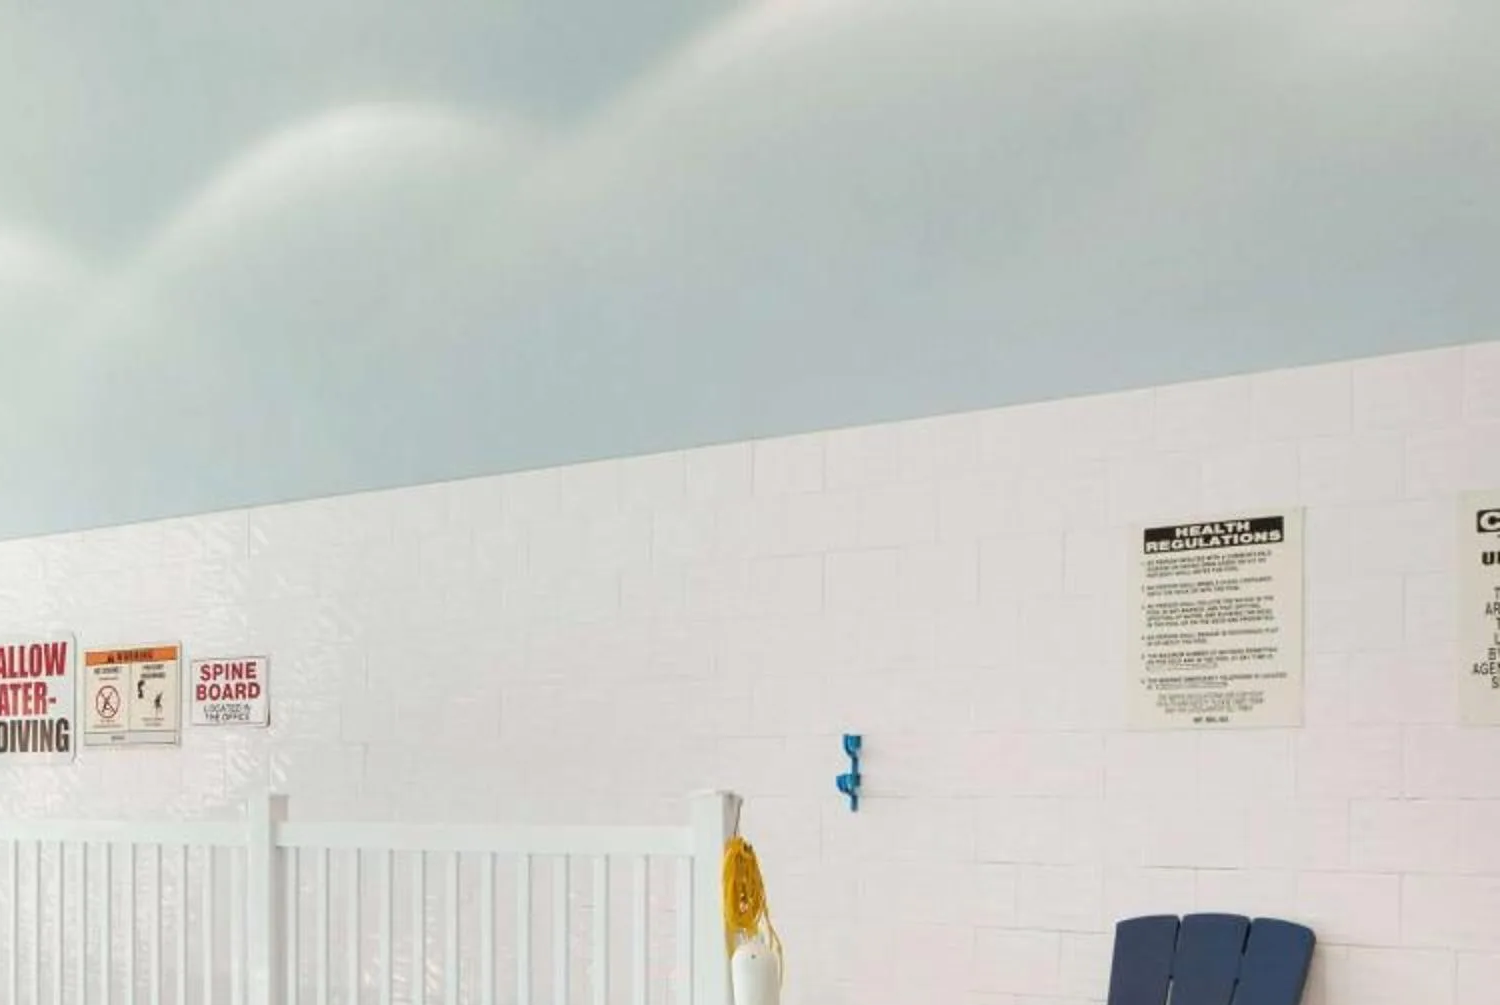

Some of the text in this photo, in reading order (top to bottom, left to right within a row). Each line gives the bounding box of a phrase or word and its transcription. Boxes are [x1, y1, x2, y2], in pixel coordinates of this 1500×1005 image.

[1175, 521, 1250, 538] HEALTH
[1145, 529, 1282, 553] REGULATIONS
[200, 661, 257, 681] SPINE
[196, 682, 261, 701] BOARD
